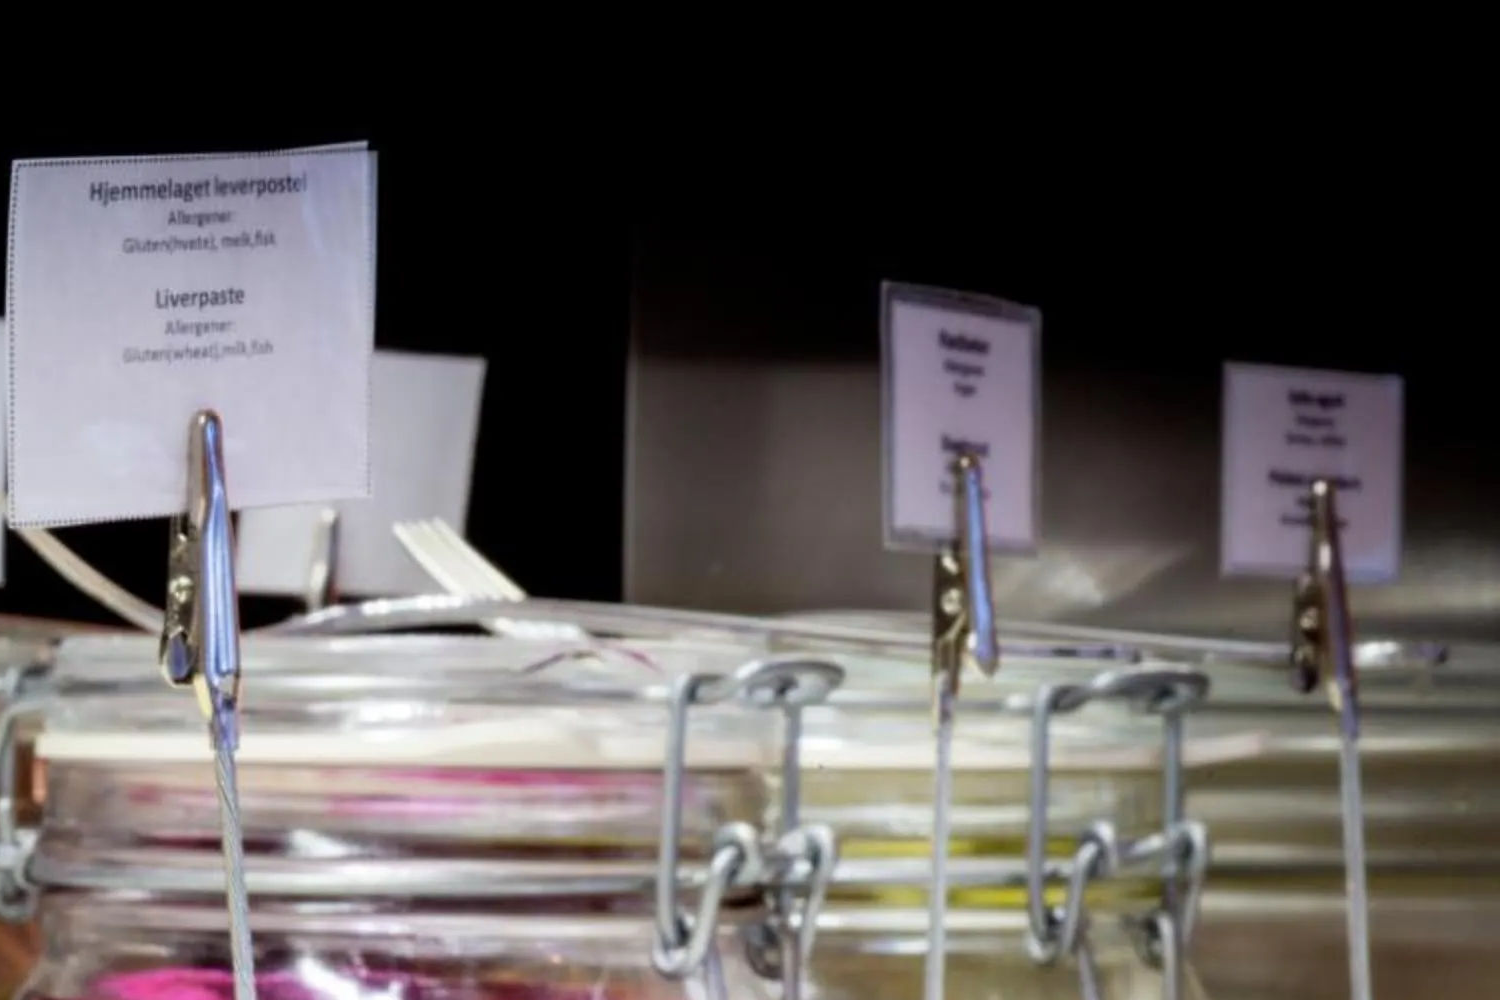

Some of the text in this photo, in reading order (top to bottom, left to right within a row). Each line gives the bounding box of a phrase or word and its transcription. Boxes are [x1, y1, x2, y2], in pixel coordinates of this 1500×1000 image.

[90, 170, 307, 207] Hjemmelaget leverpostei
[155, 288, 245, 311] Liverpaste
